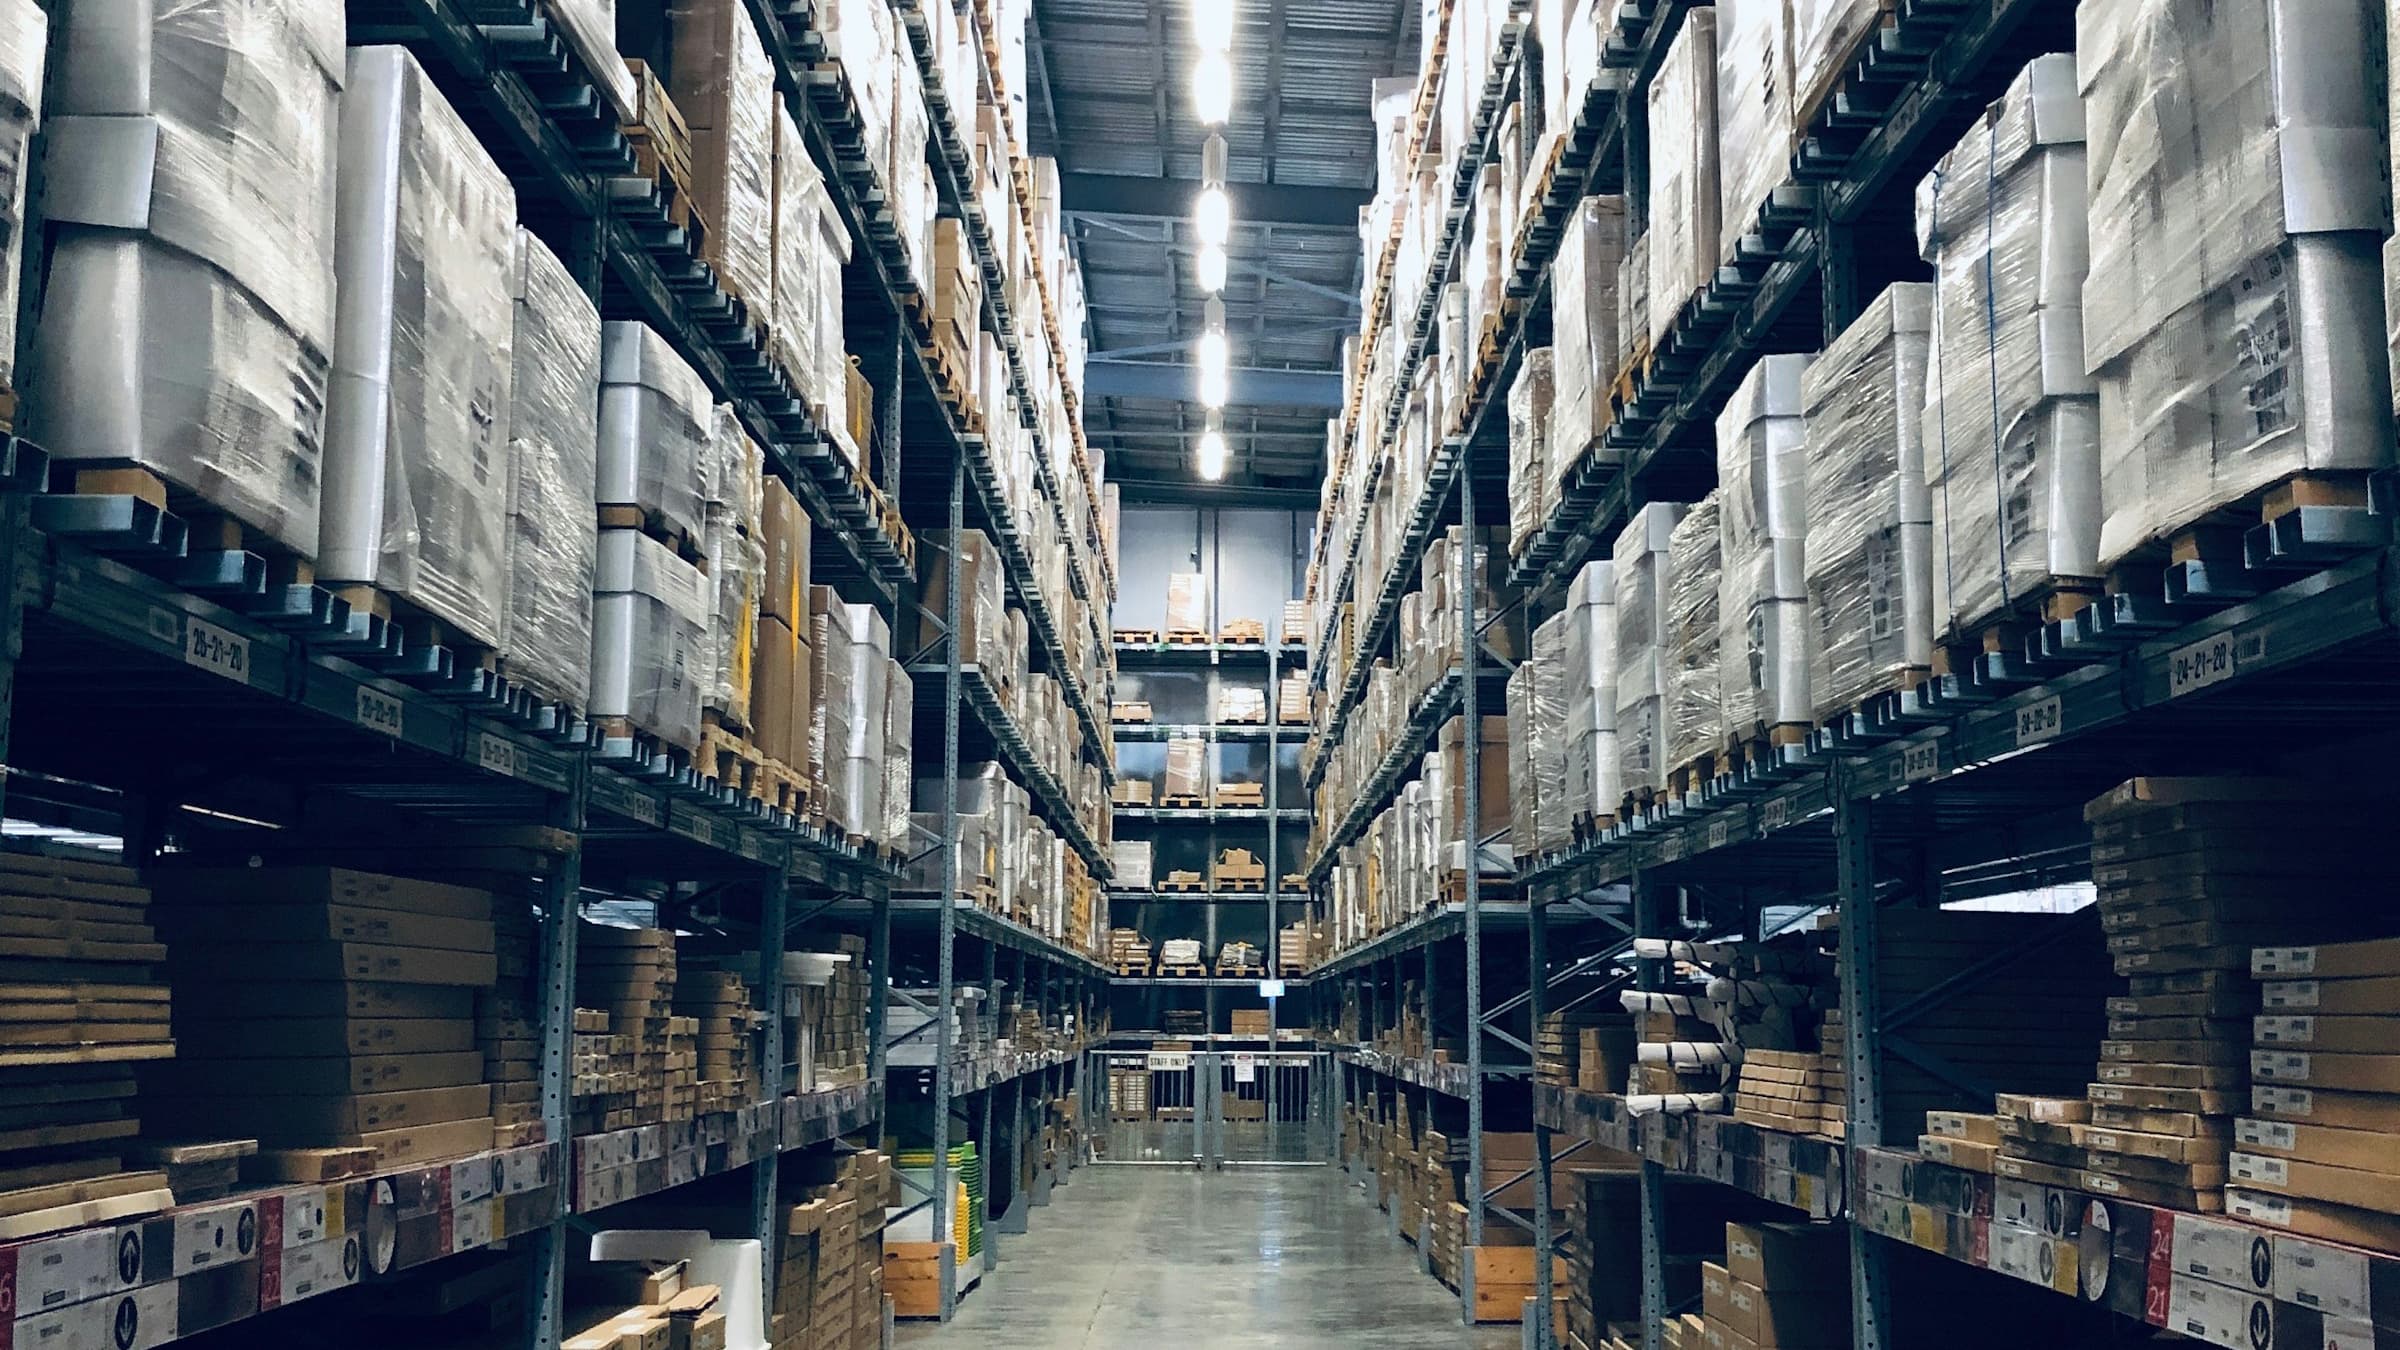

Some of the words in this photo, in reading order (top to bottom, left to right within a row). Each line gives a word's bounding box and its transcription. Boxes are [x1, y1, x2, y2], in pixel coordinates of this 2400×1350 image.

[2176, 640, 2227, 685] 24-21-20
[1150, 1057, 1168, 1066] STAFF
[1170, 1057, 1185, 1067] ONLY
[2151, 1228, 2170, 1260] 24
[2147, 1285, 2166, 1320] 21
